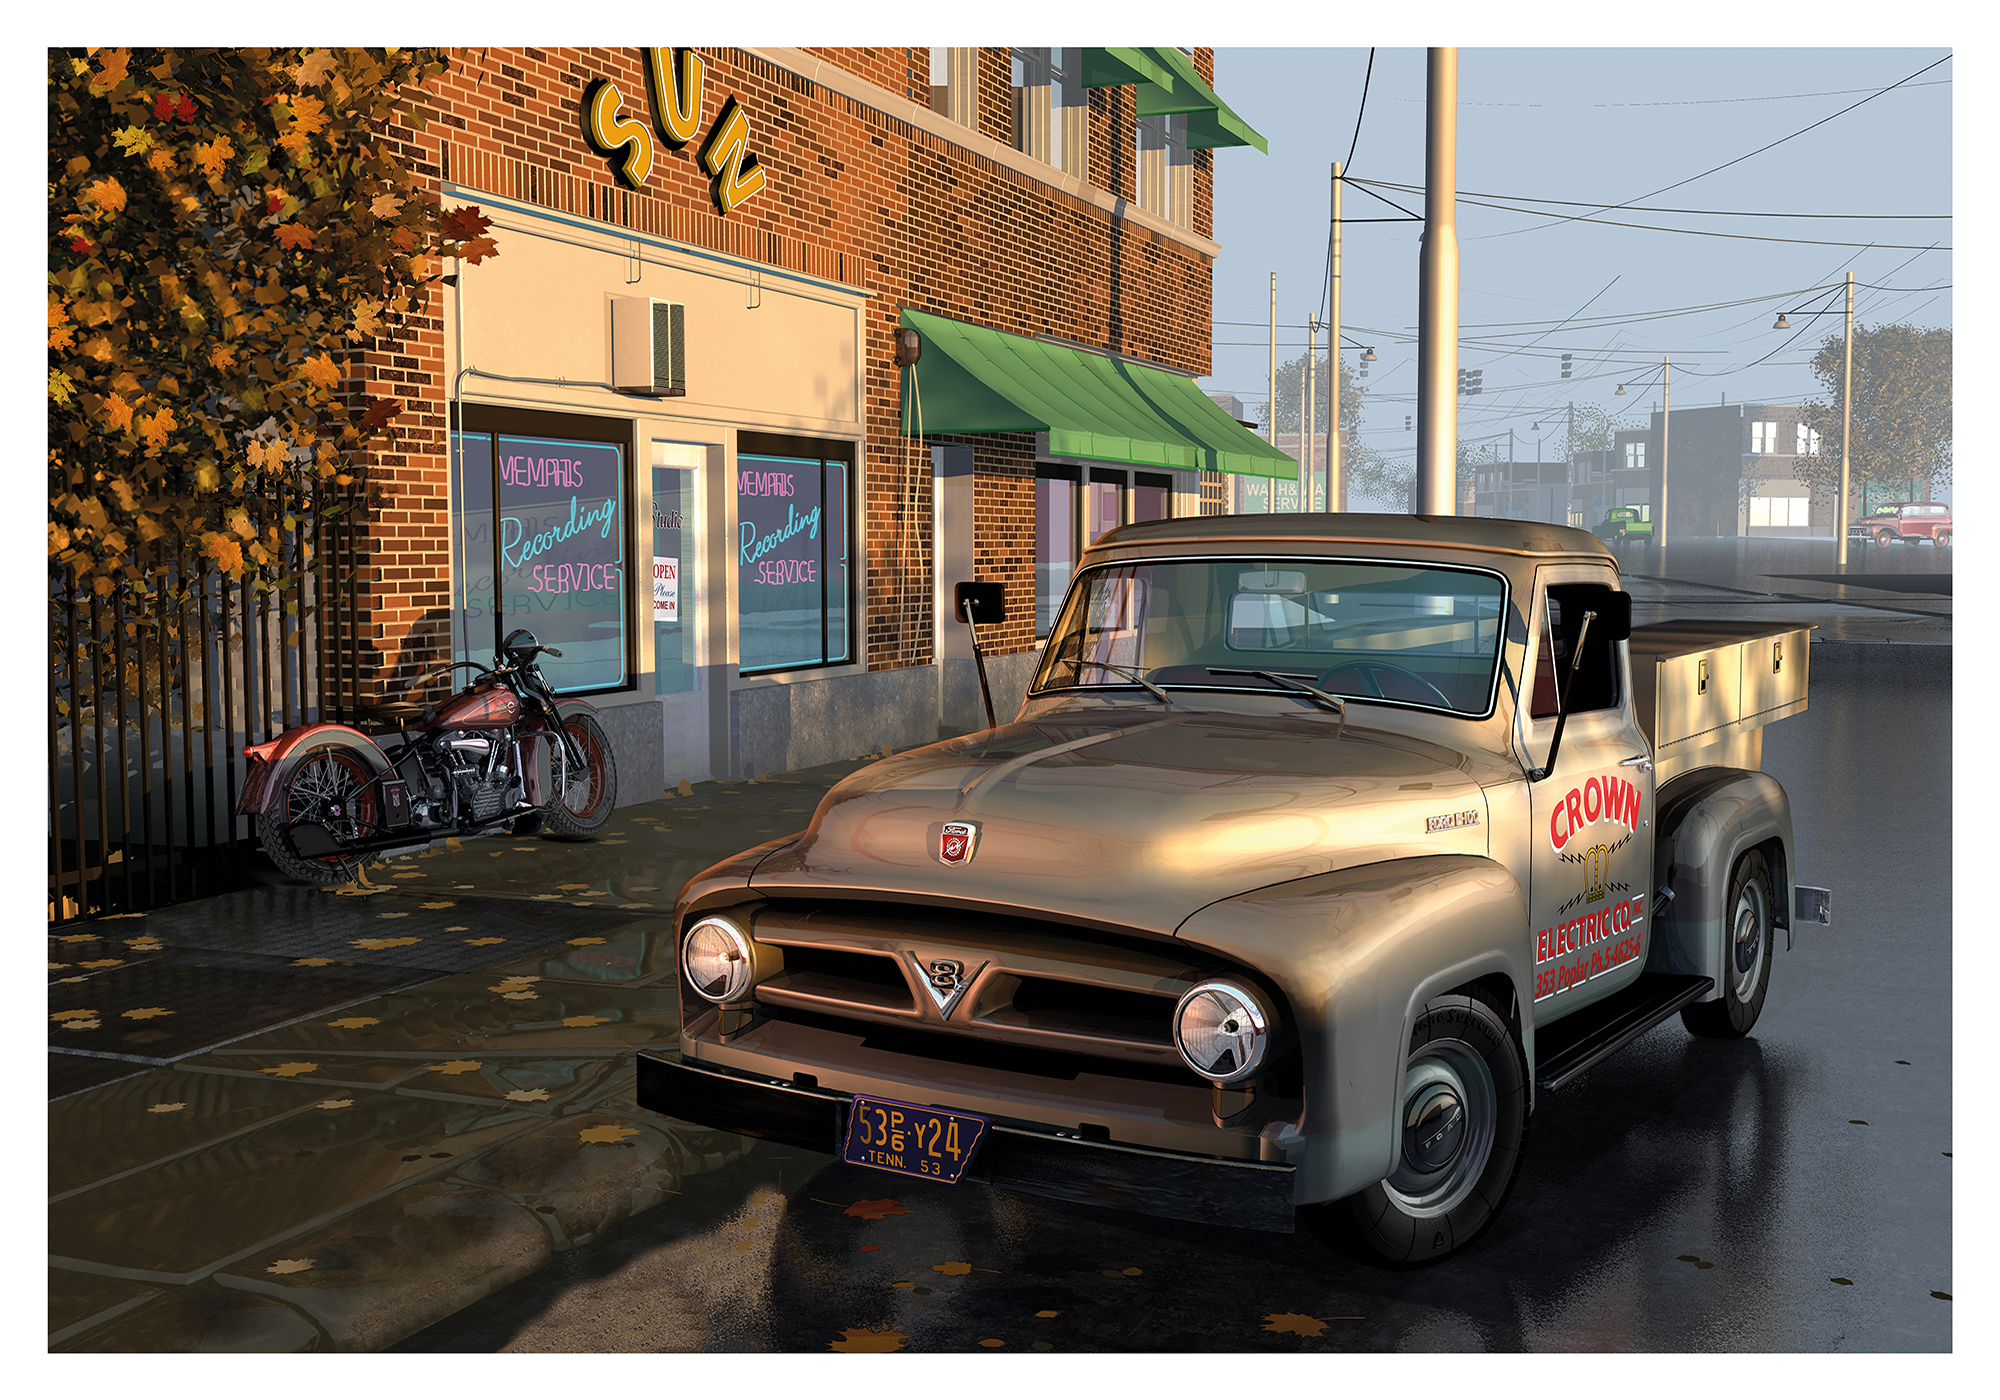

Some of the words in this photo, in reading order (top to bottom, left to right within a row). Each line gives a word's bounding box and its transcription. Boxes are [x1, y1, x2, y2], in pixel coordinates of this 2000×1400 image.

[588, 47, 767, 213] SUN
[499, 455, 583, 487] MEMPHIS
[737, 470, 794, 497] MEMPHIS
[653, 501, 684, 529] Studio
[500, 495, 616, 571] Recording
[739, 503, 821, 566] Recording
[527, 563, 615, 593] SERVICE
[653, 564, 676, 579] OPEN
[754, 560, 816, 585] SERVICE
[654, 582, 675, 598] Please
[669, 601, 675, 610] IN
[1426, 814, 1453, 831] FORD
[1550, 776, 1642, 853] CROWN
[1536, 907, 1610, 965] ELECTRIC
[1612, 900, 1631, 936] CO.
[1535, 968, 1556, 999] 353
[1558, 957, 1590, 992] Poplar
[868, 1150, 907, 1169] TENN.
[920, 1159, 941, 1175] 53
